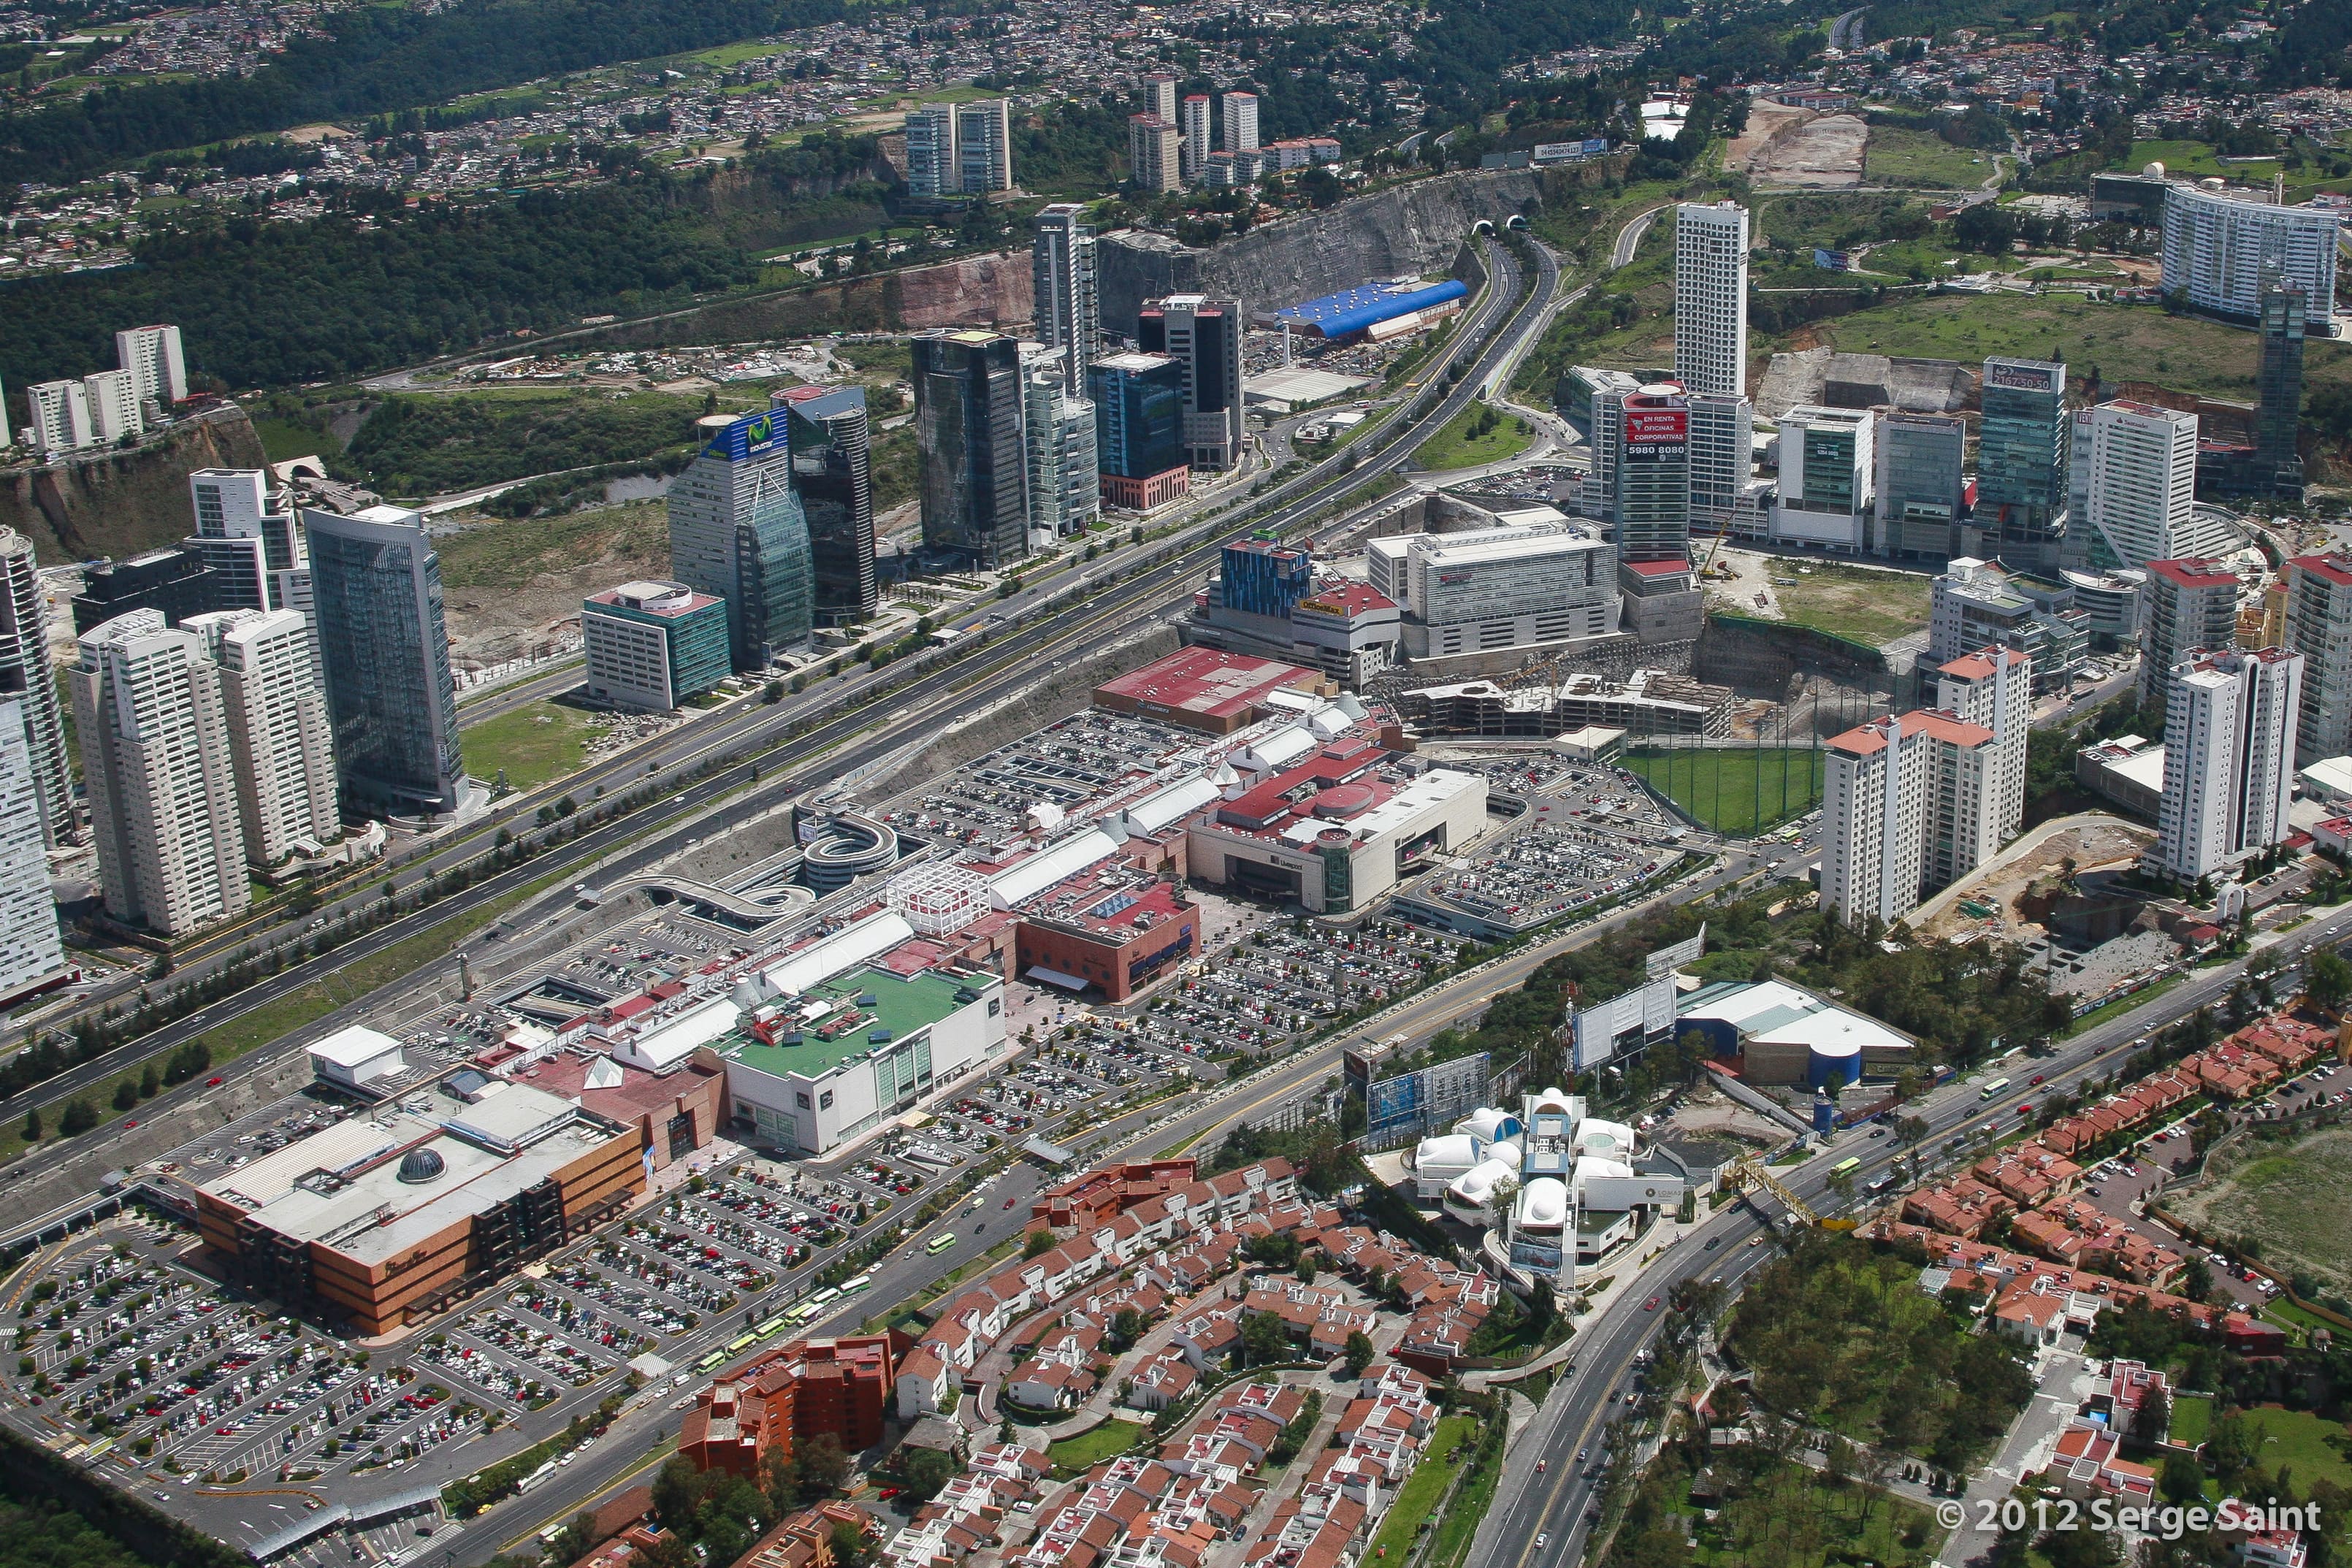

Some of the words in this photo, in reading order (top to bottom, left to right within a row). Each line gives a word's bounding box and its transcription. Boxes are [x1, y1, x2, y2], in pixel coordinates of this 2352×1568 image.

[1993, 375, 2050, 389] 2167-50-50
[1629, 446, 1655, 454] 5980
[1658, 446, 1684, 454] 8080
